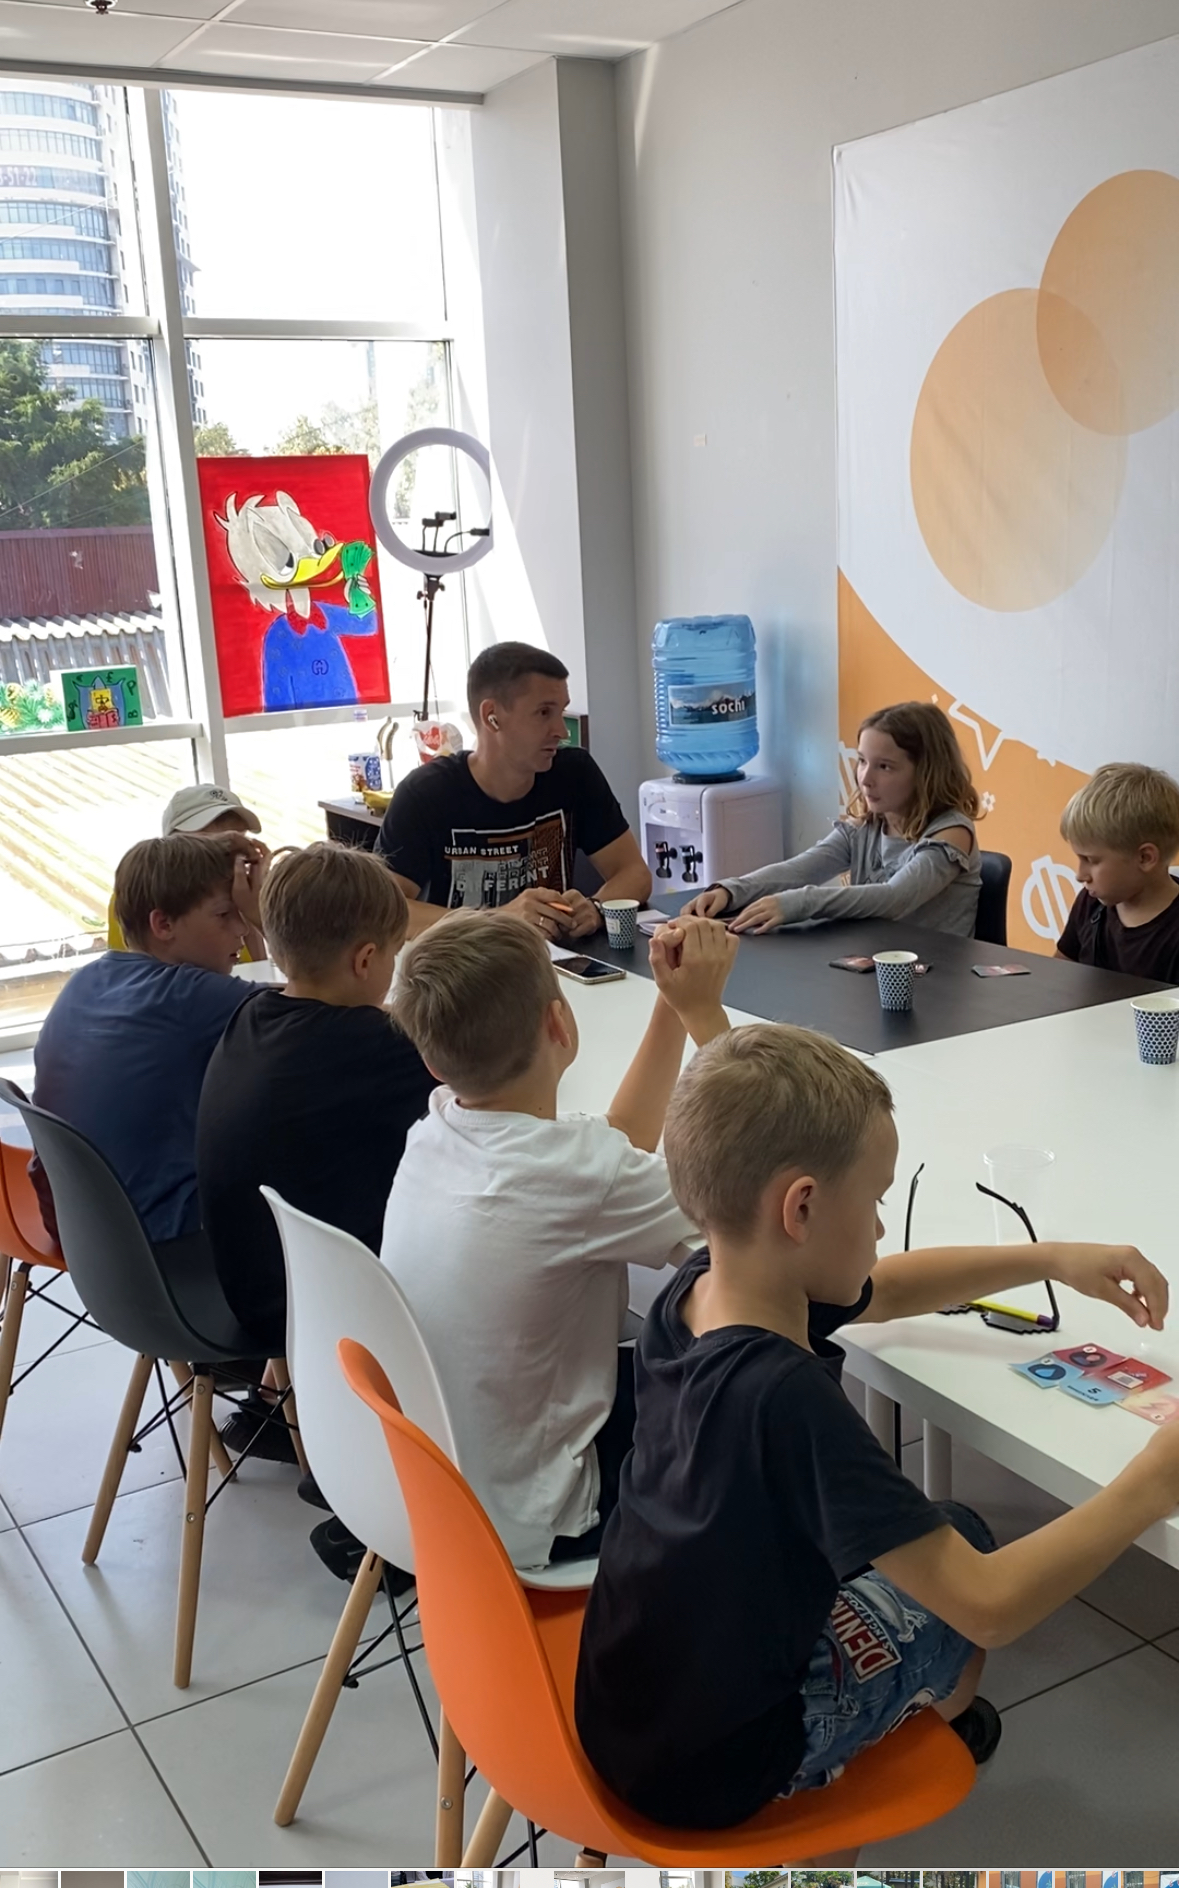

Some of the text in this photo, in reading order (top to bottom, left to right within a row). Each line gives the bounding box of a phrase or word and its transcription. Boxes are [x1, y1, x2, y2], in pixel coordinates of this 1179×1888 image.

[711, 699, 745, 715] sochi
[444, 845, 519, 856] URBAN STREET
